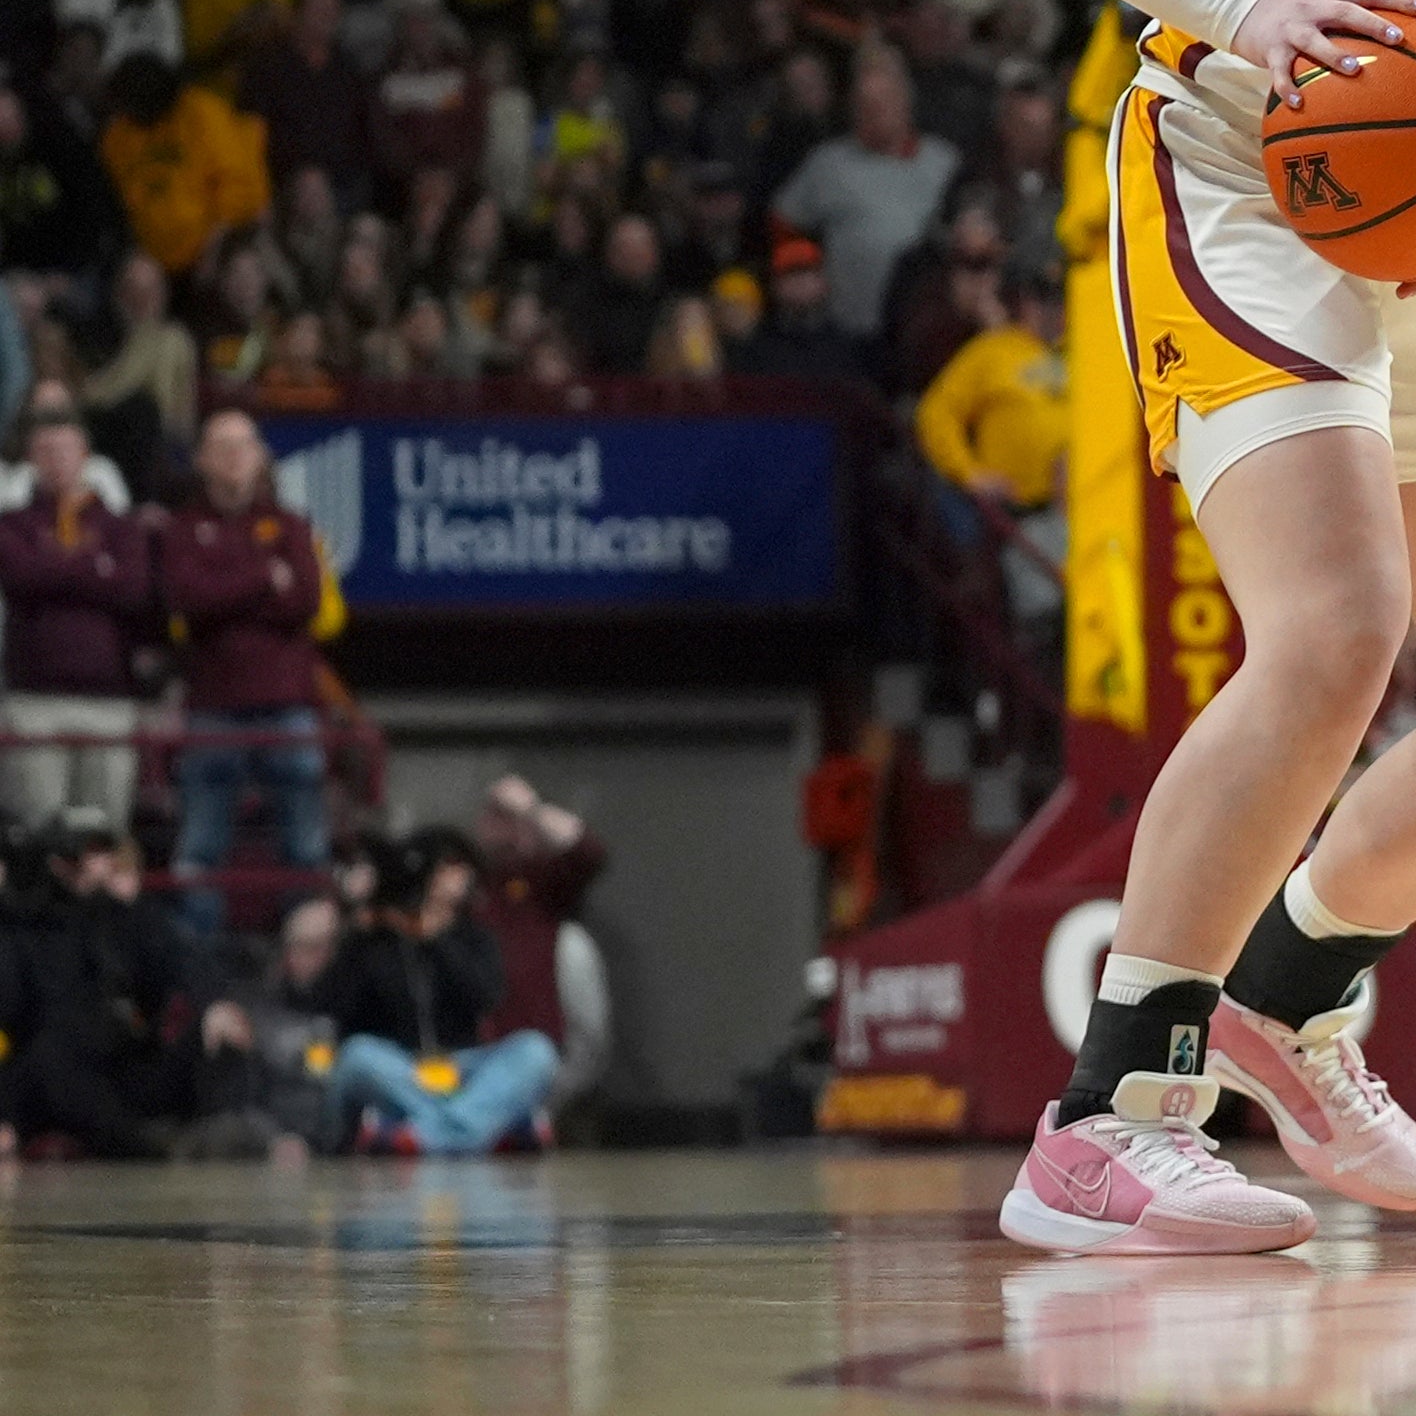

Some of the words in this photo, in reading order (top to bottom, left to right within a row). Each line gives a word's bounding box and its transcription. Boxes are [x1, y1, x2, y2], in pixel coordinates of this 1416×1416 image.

[1282, 150, 1361, 216] M
[394, 436, 602, 501] United
[394, 503, 732, 574] Healthcare
